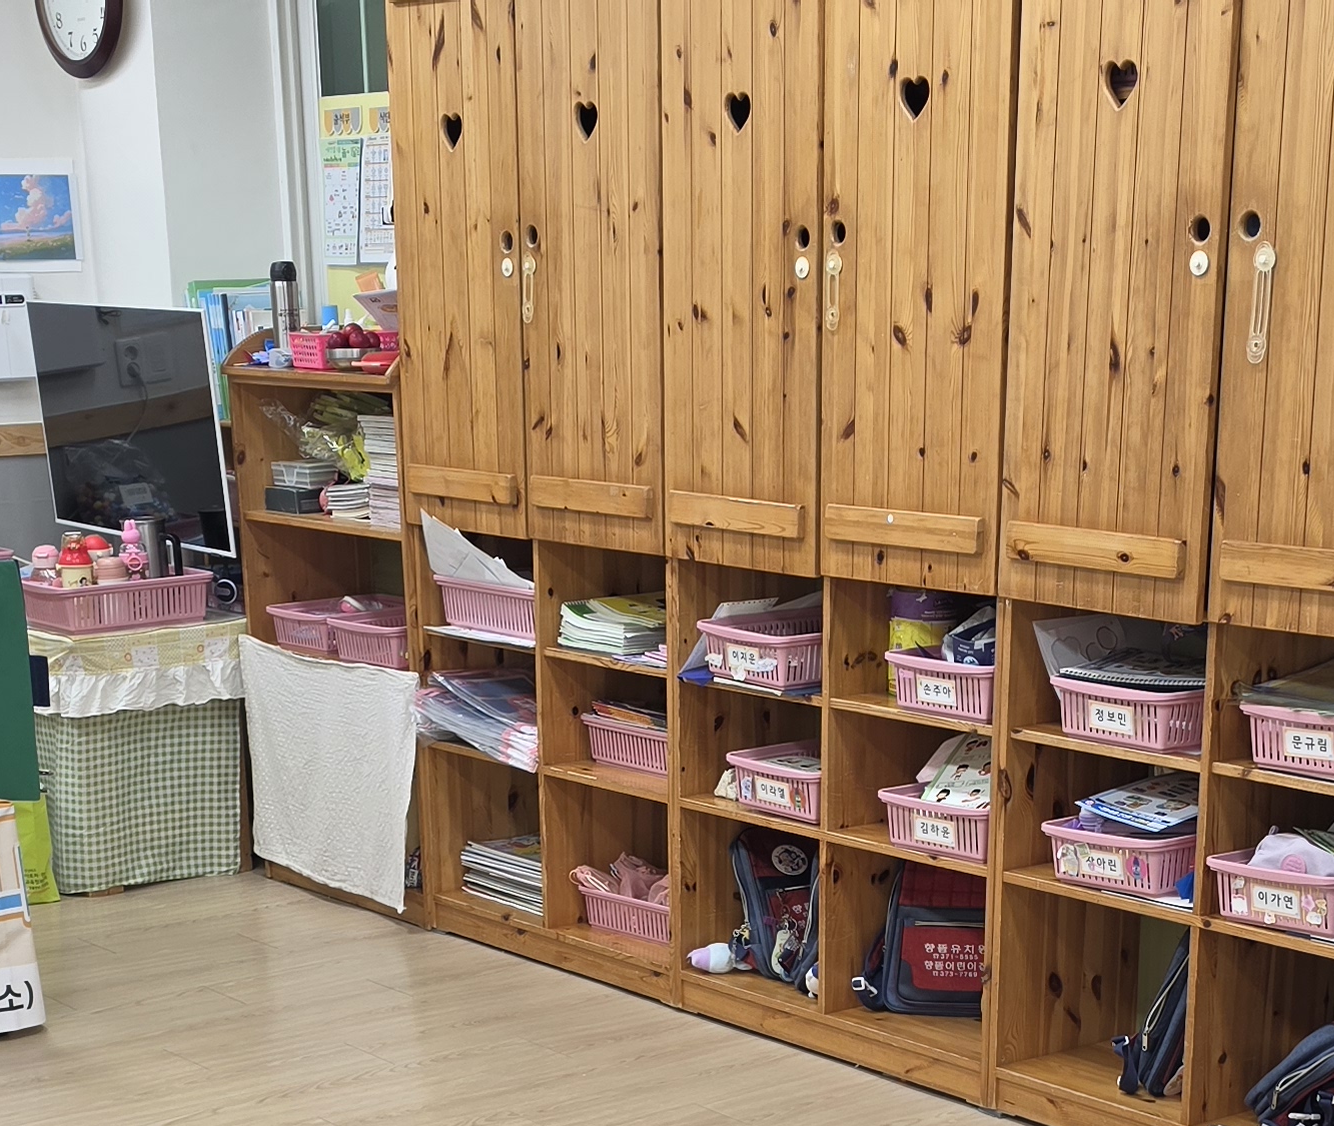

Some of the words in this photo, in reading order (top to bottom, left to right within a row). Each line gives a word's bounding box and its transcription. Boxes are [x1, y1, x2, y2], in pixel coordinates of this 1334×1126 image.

[55, 12, 63, 29] 8
[67, 31, 74, 48] 7
[80, 34, 87, 52] 6
[923, 683, 951, 698] 손주아
[1095, 708, 1126, 726] 정보민
[1291, 735, 1327, 752] 문규림
[1258, 891, 1293, 909] 이가연
